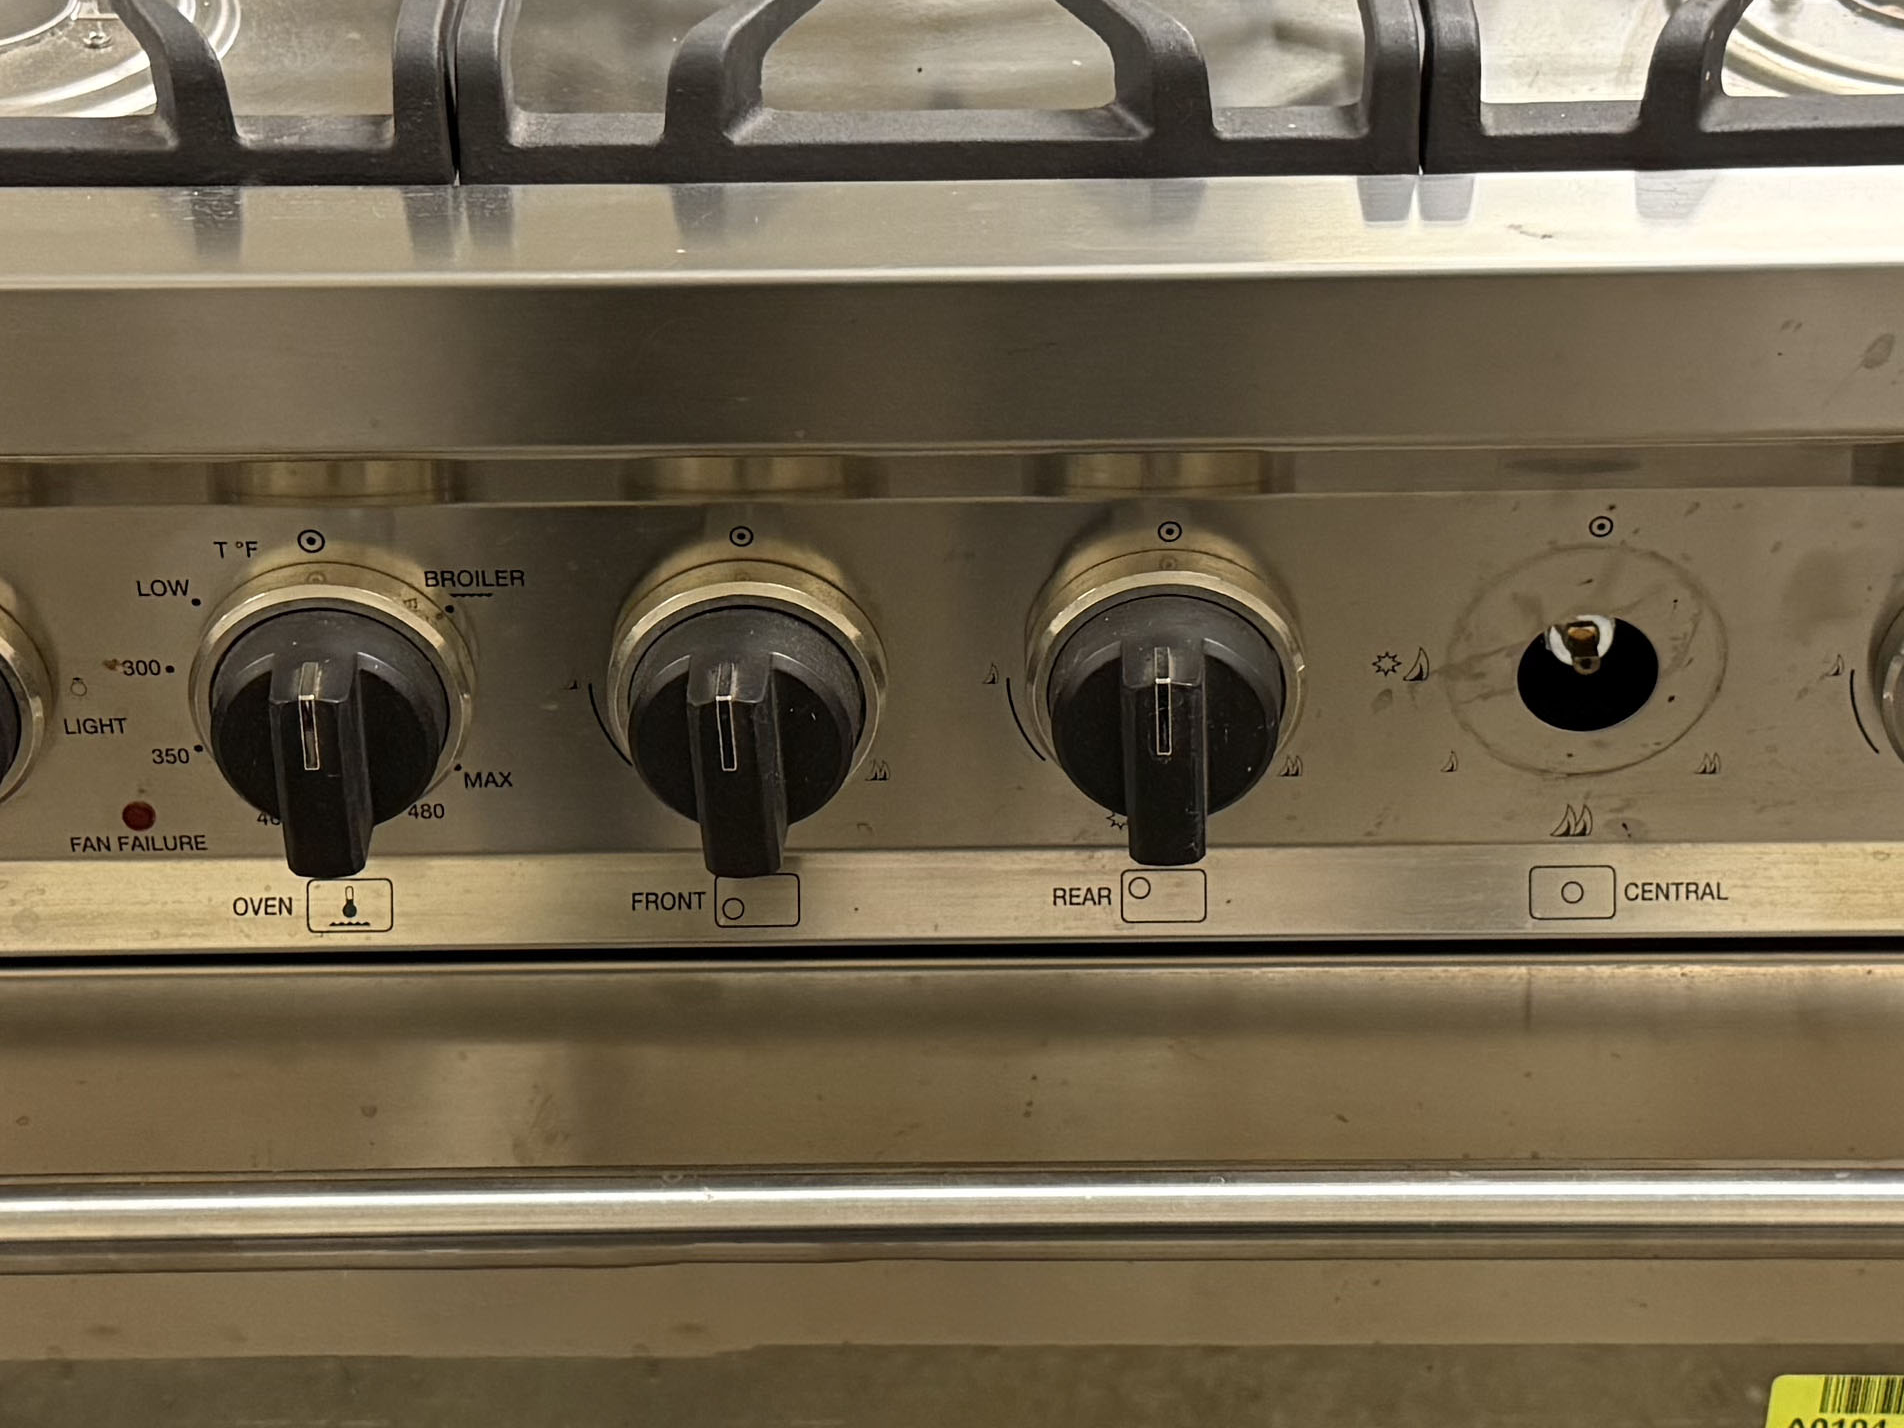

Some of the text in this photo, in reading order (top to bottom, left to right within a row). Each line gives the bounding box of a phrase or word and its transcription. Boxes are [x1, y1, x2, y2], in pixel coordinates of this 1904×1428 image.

[425, 570, 525, 588] BROILER
[137, 580, 189, 597] LOW
[123, 660, 161, 676] 300
[64, 718, 126, 735] LIGHT
[152, 748, 189, 764] 350
[464, 772, 512, 788] MAX
[408, 803, 444, 819] 480
[71, 835, 207, 852] FAN FAILURE
[1053, 888, 1112, 906] REAR
[1624, 883, 1728, 901] CENTRAL
[233, 897, 292, 915] OVEN
[631, 892, 706, 911] FRONT
